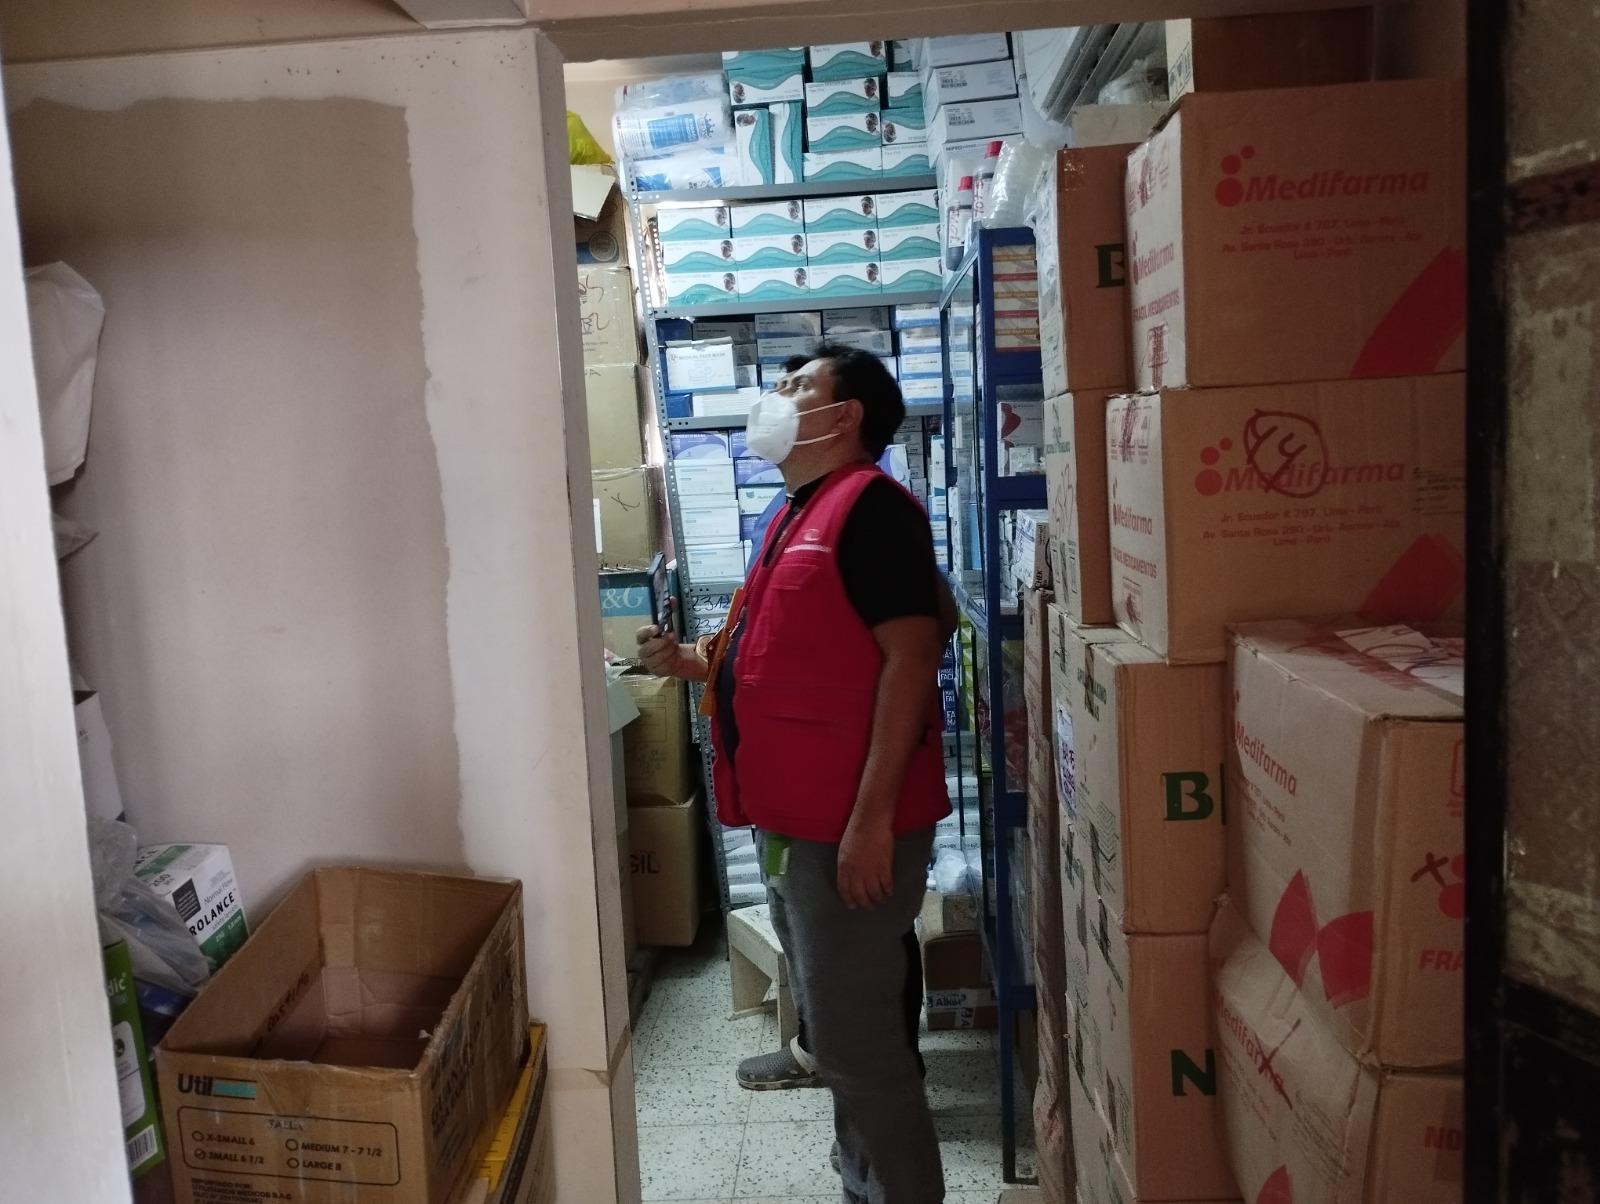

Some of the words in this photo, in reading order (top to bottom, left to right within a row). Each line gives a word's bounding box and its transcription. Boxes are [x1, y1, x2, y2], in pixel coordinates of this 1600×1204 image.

[1245, 169, 1430, 202] Medifarma
[1224, 461, 1406, 492] Medifarma
[1238, 511, 1280, 522] Ecuador
[1221, 529, 1251, 539] Santa
[1235, 720, 1297, 797] Medifarma
[1161, 771, 1214, 821] B
[178, 1073, 213, 1097] Util
[268, 1119, 304, 1131] TALLA
[207, 1133, 247, 1145] X-SMALL
[249, 1137, 256, 1146] 6
[301, 1143, 340, 1154] MEDIUM
[341, 1145, 348, 1154] 7
[357, 1147, 364, 1155] 7
[367, 1147, 382, 1157] 1/2
[208, 1152, 238, 1163] SMALL
[240, 1154, 247, 1163] 6
[249, 1155, 264, 1165] 1/2
[302, 1160, 333, 1171] LARGE
[335, 1162, 342, 1171] 8
